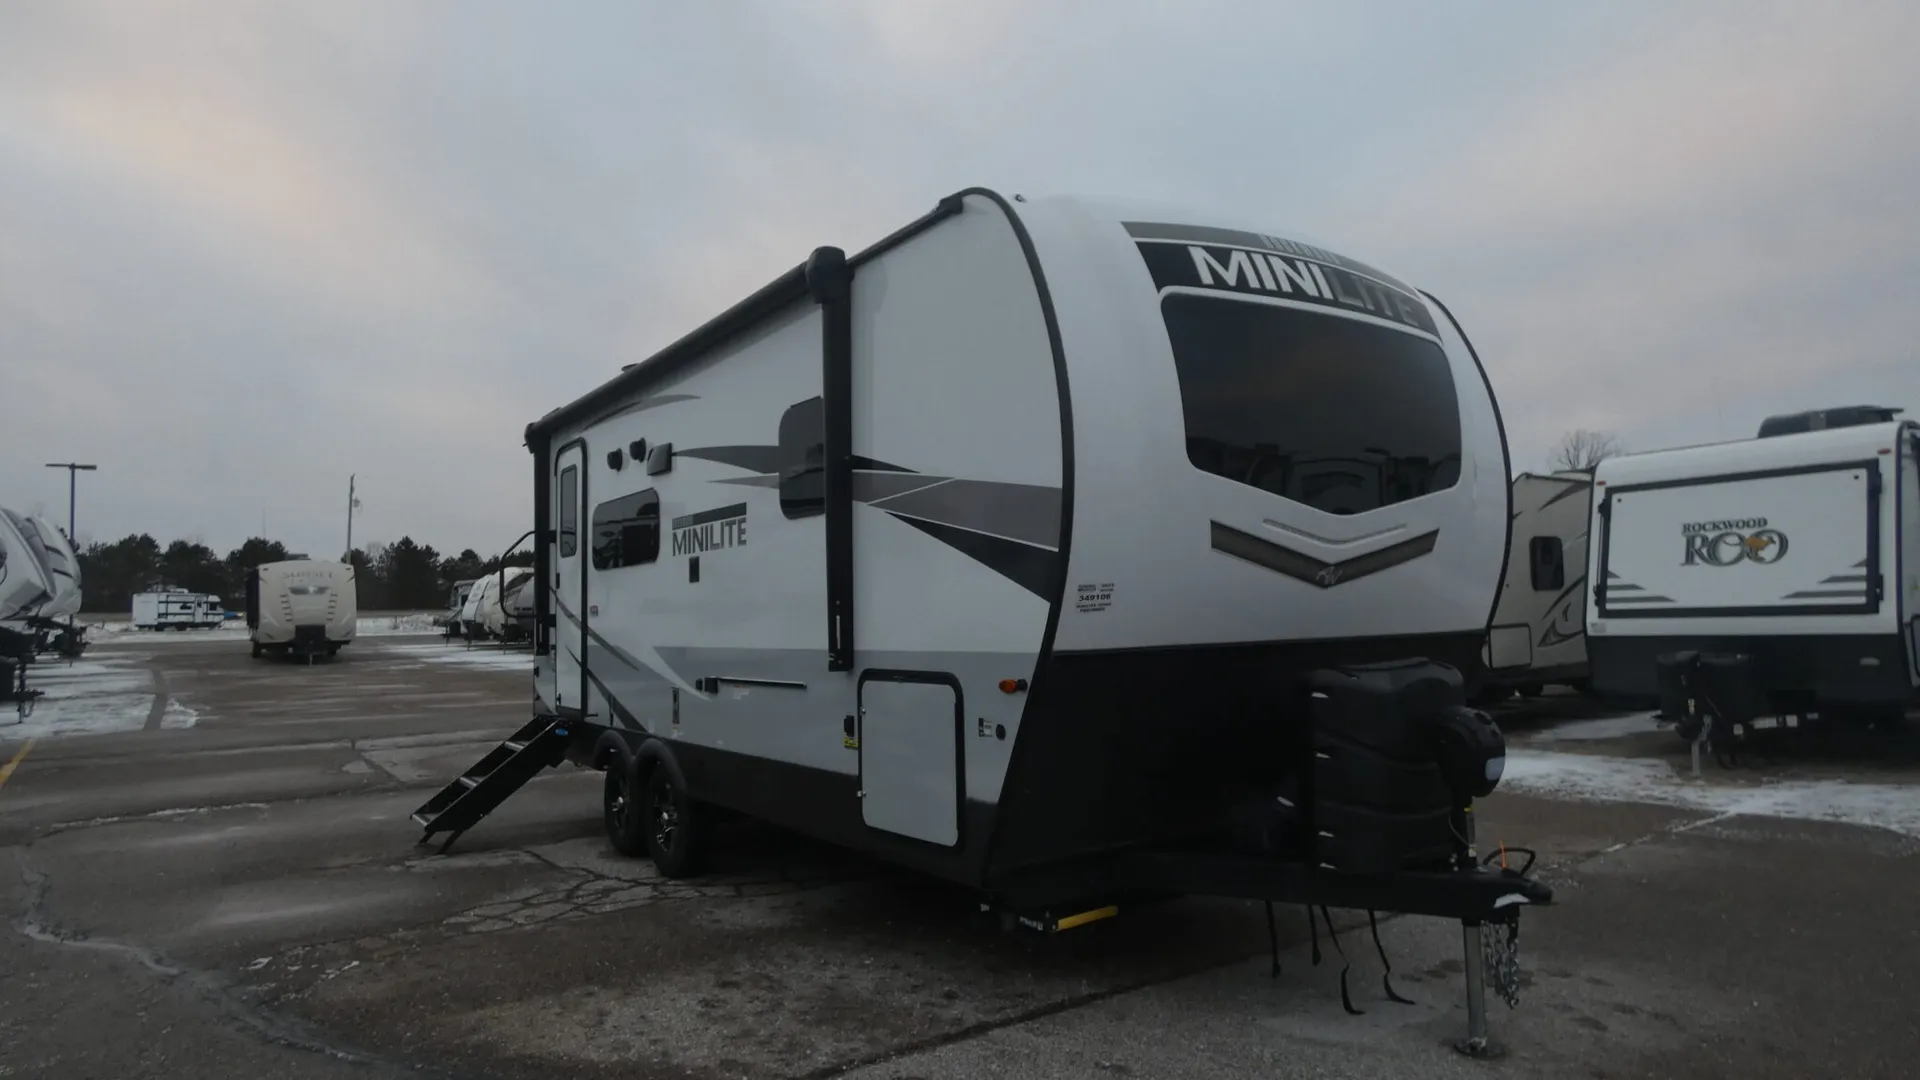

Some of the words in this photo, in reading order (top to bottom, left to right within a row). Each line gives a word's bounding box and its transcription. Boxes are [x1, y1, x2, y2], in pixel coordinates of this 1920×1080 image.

[1187, 245, 1421, 327] MINILITE
[672, 517, 746, 556] MINILITE
[1682, 517, 1768, 533] ROCKWOOD
[1679, 530, 1789, 567] ROO
